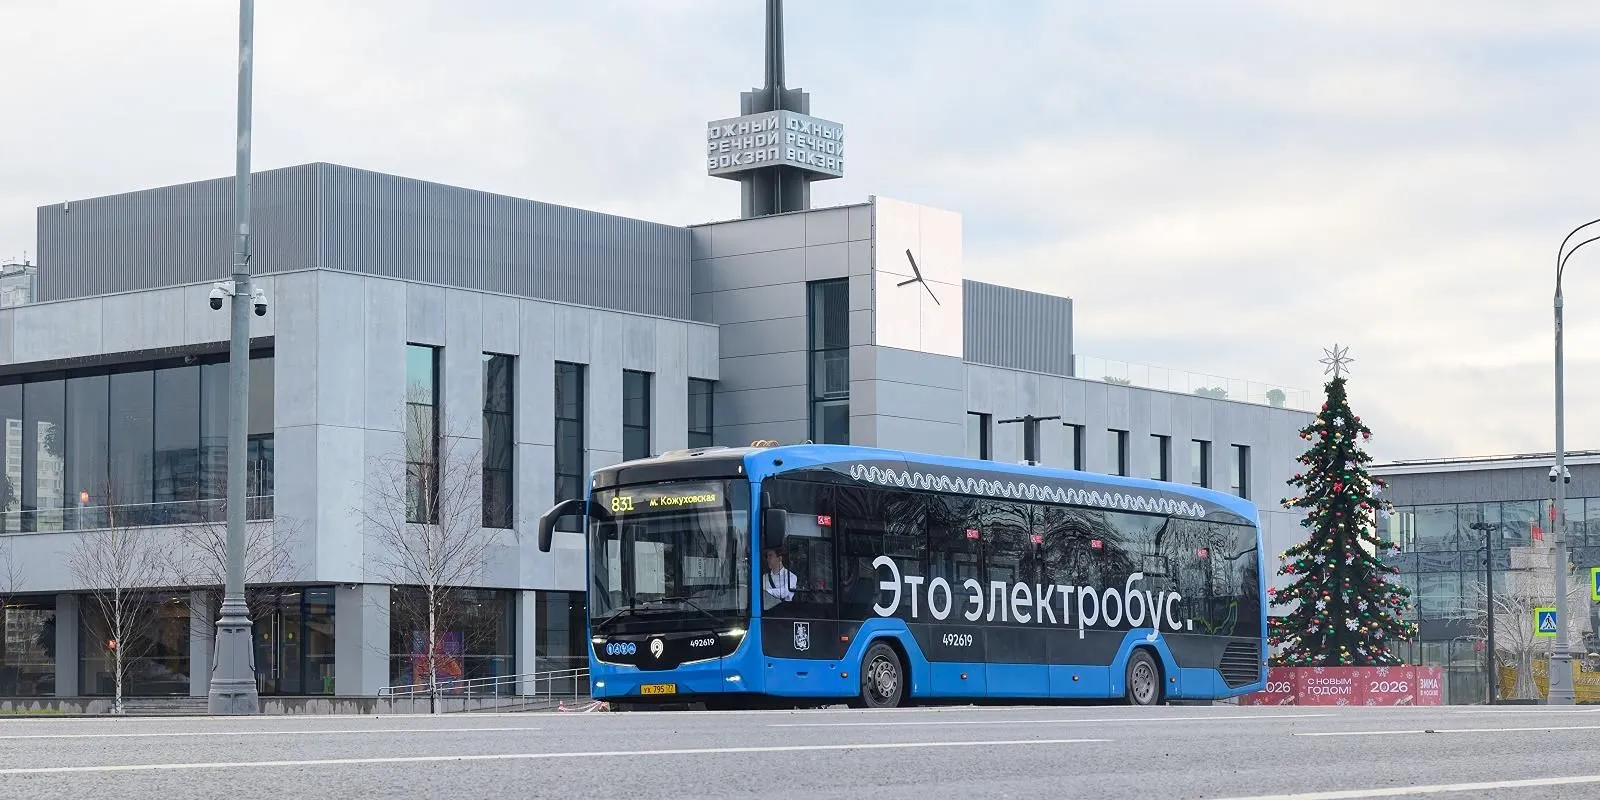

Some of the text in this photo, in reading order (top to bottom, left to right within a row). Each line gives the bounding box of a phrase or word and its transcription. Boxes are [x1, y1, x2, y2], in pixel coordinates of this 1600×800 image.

[708, 131, 780, 154] РЕЧНОЙ
[708, 147, 780, 169] ВОКЗАЛ
[611, 496, 634, 512] 831
[660, 494, 716, 506] Кожуховская
[871, 555, 1193, 641] Это электробус.
[690, 638, 715, 648] 492619
[942, 633, 973, 647] 492619
[1257, 681, 1291, 693] 026
[1370, 681, 1408, 693] 2026
[1420, 678, 1438, 688] ЗИМА
[652, 685, 665, 694] 795
[1307, 686, 1352, 695] ГОДОМ!
